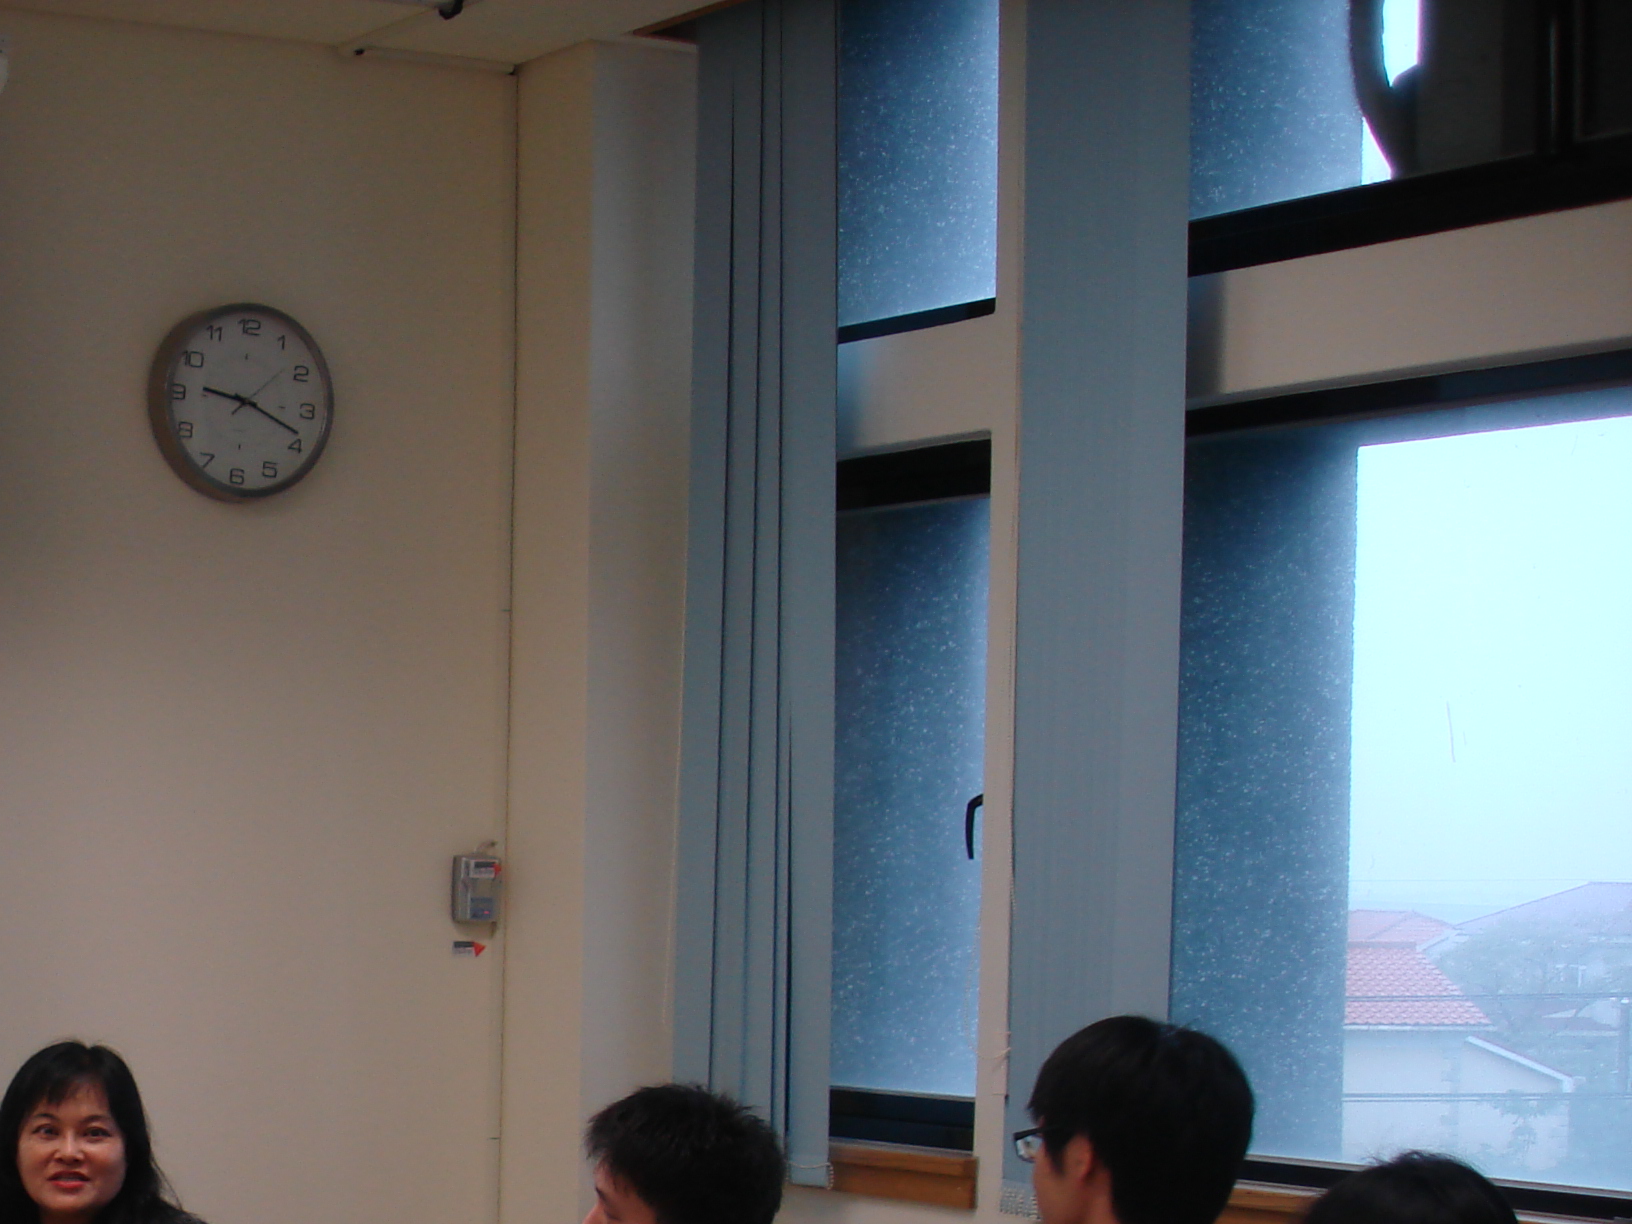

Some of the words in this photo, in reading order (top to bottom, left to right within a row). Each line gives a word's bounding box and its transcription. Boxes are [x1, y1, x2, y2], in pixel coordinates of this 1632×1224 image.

[206, 325, 223, 341] 11
[238, 318, 261, 336] 12
[277, 335, 285, 350] 1
[182, 350, 204, 368] 10
[293, 365, 309, 382] 2
[171, 383, 186, 400] 9
[299, 403, 315, 420] 3
[178, 421, 193, 438] 8
[288, 438, 302, 453] 4
[200, 452, 215, 468] 7
[229, 468, 244, 485] 6
[262, 461, 277, 478] 5
